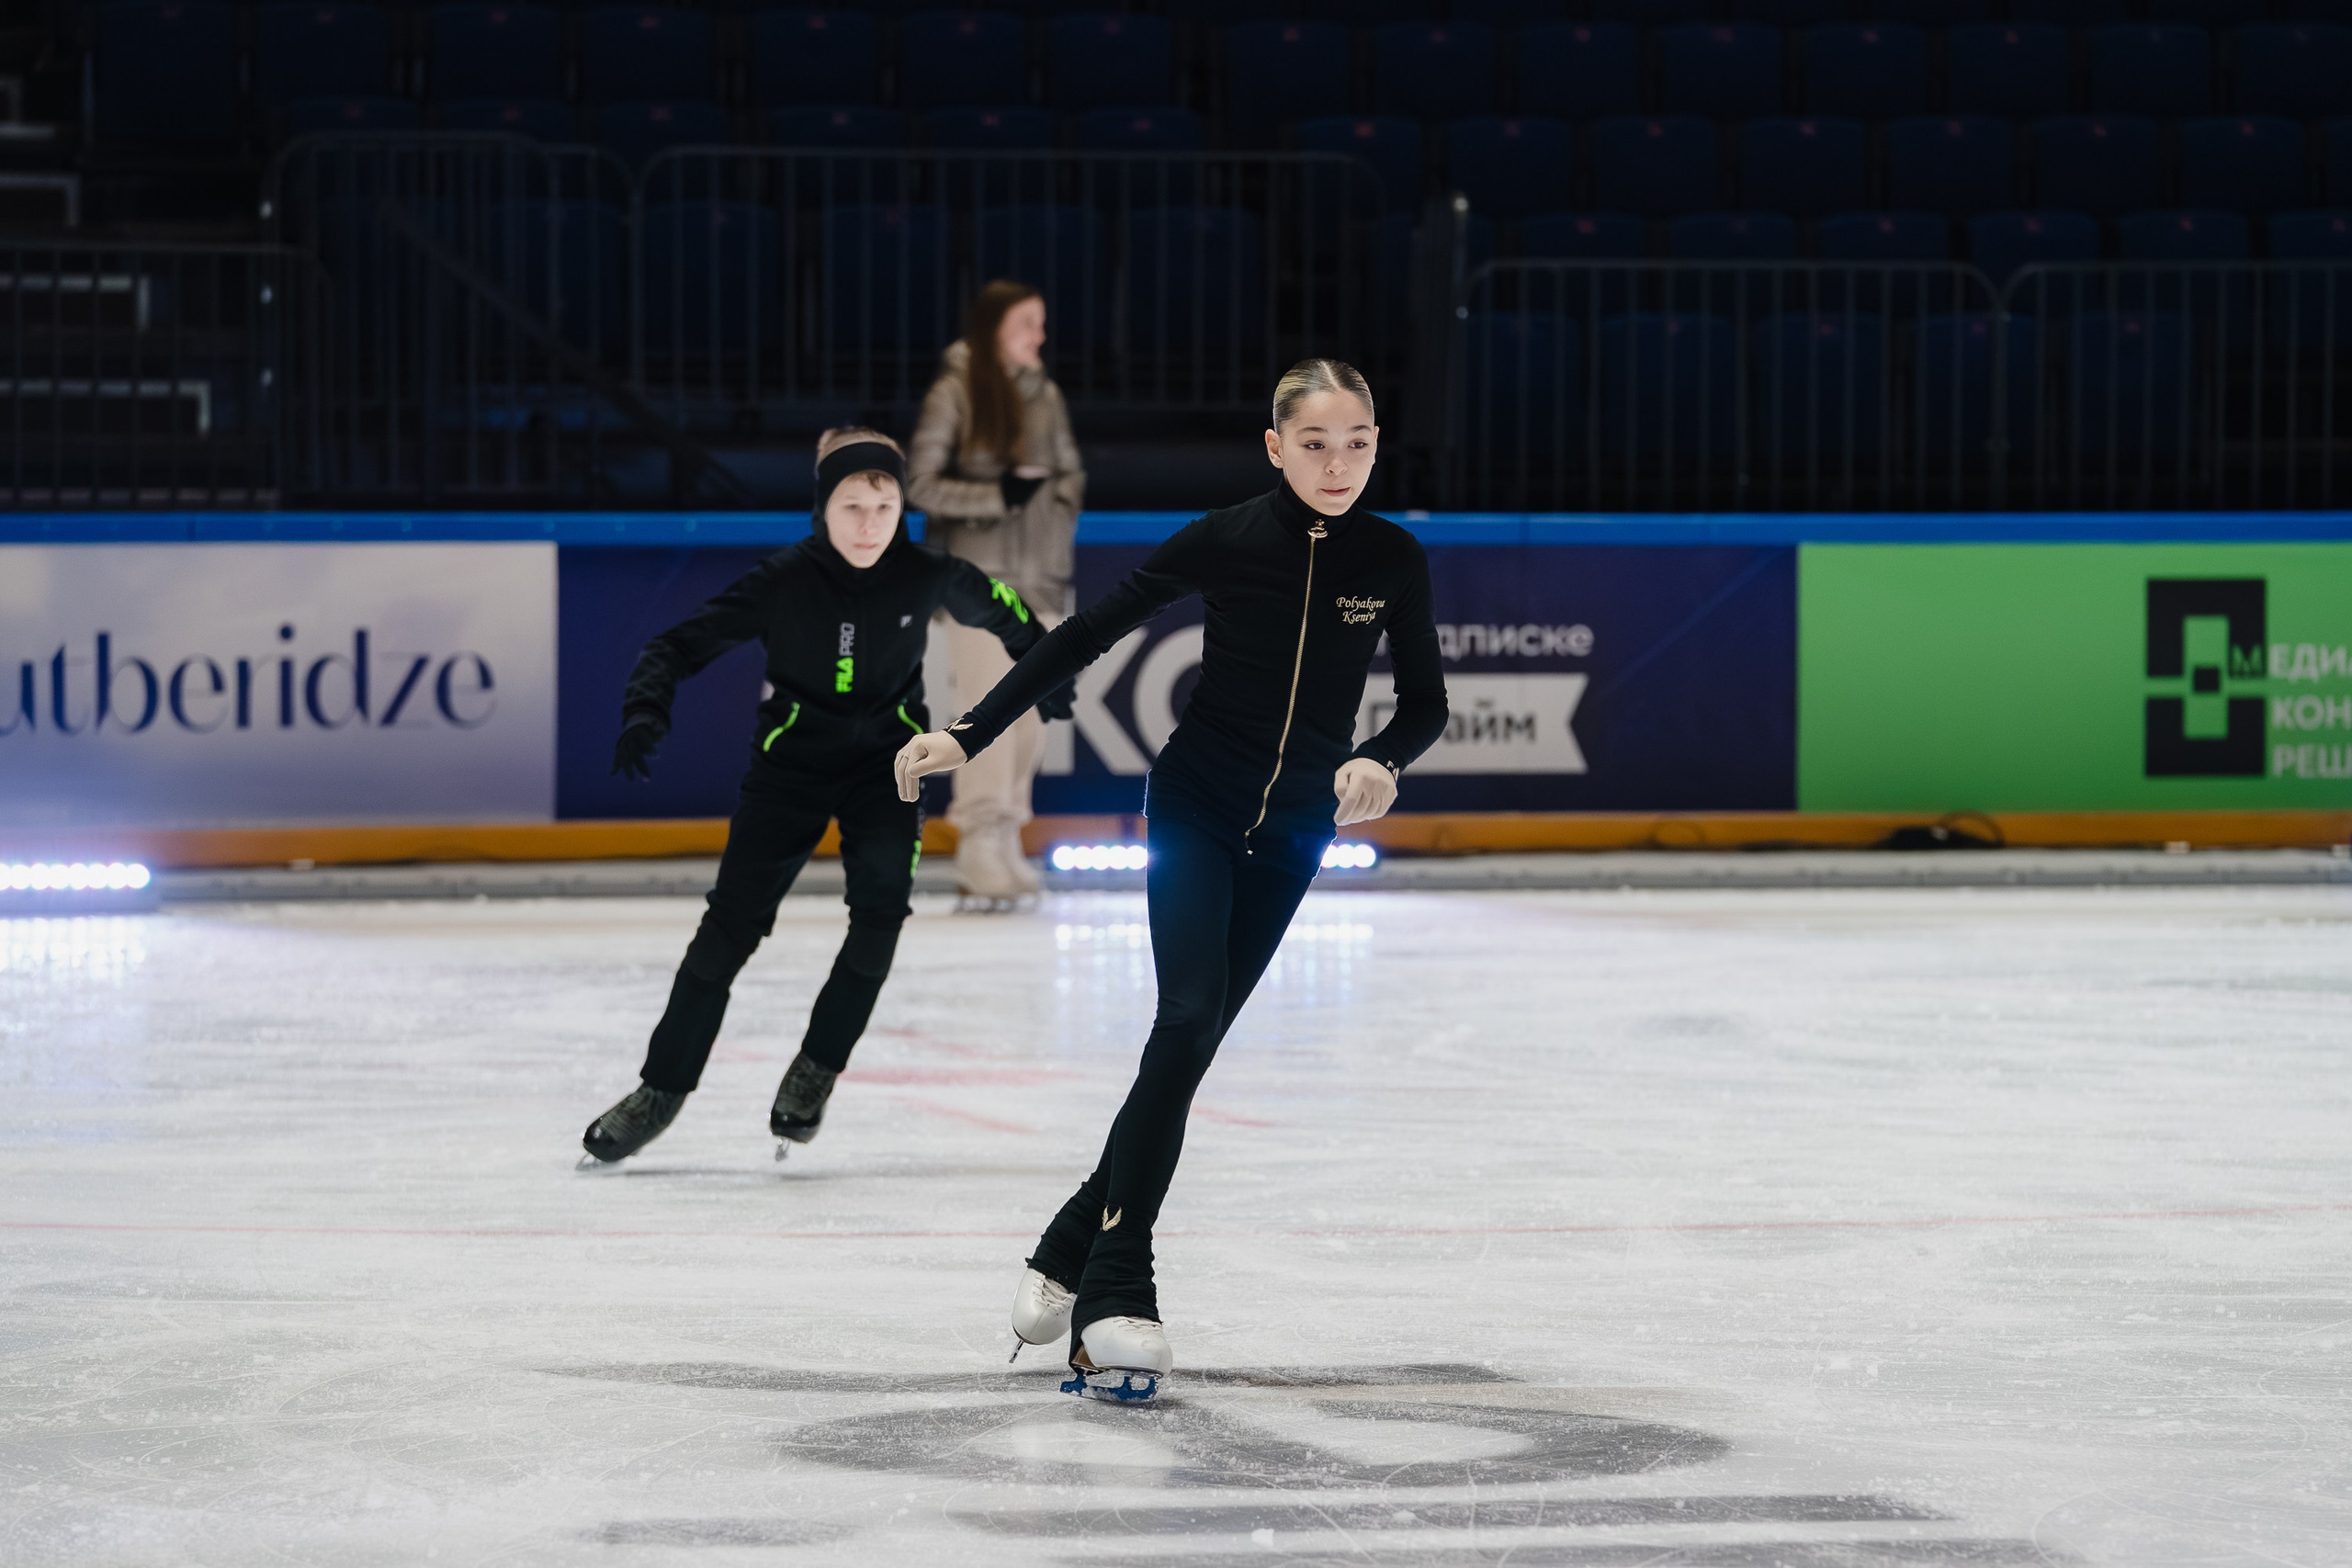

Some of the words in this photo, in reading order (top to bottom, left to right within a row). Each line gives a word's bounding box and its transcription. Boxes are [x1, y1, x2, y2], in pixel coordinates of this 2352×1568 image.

[838, 622, 855, 657] PRO
[835, 656, 854, 693] FILA
[2231, 643, 2352, 684] МЕДИ
